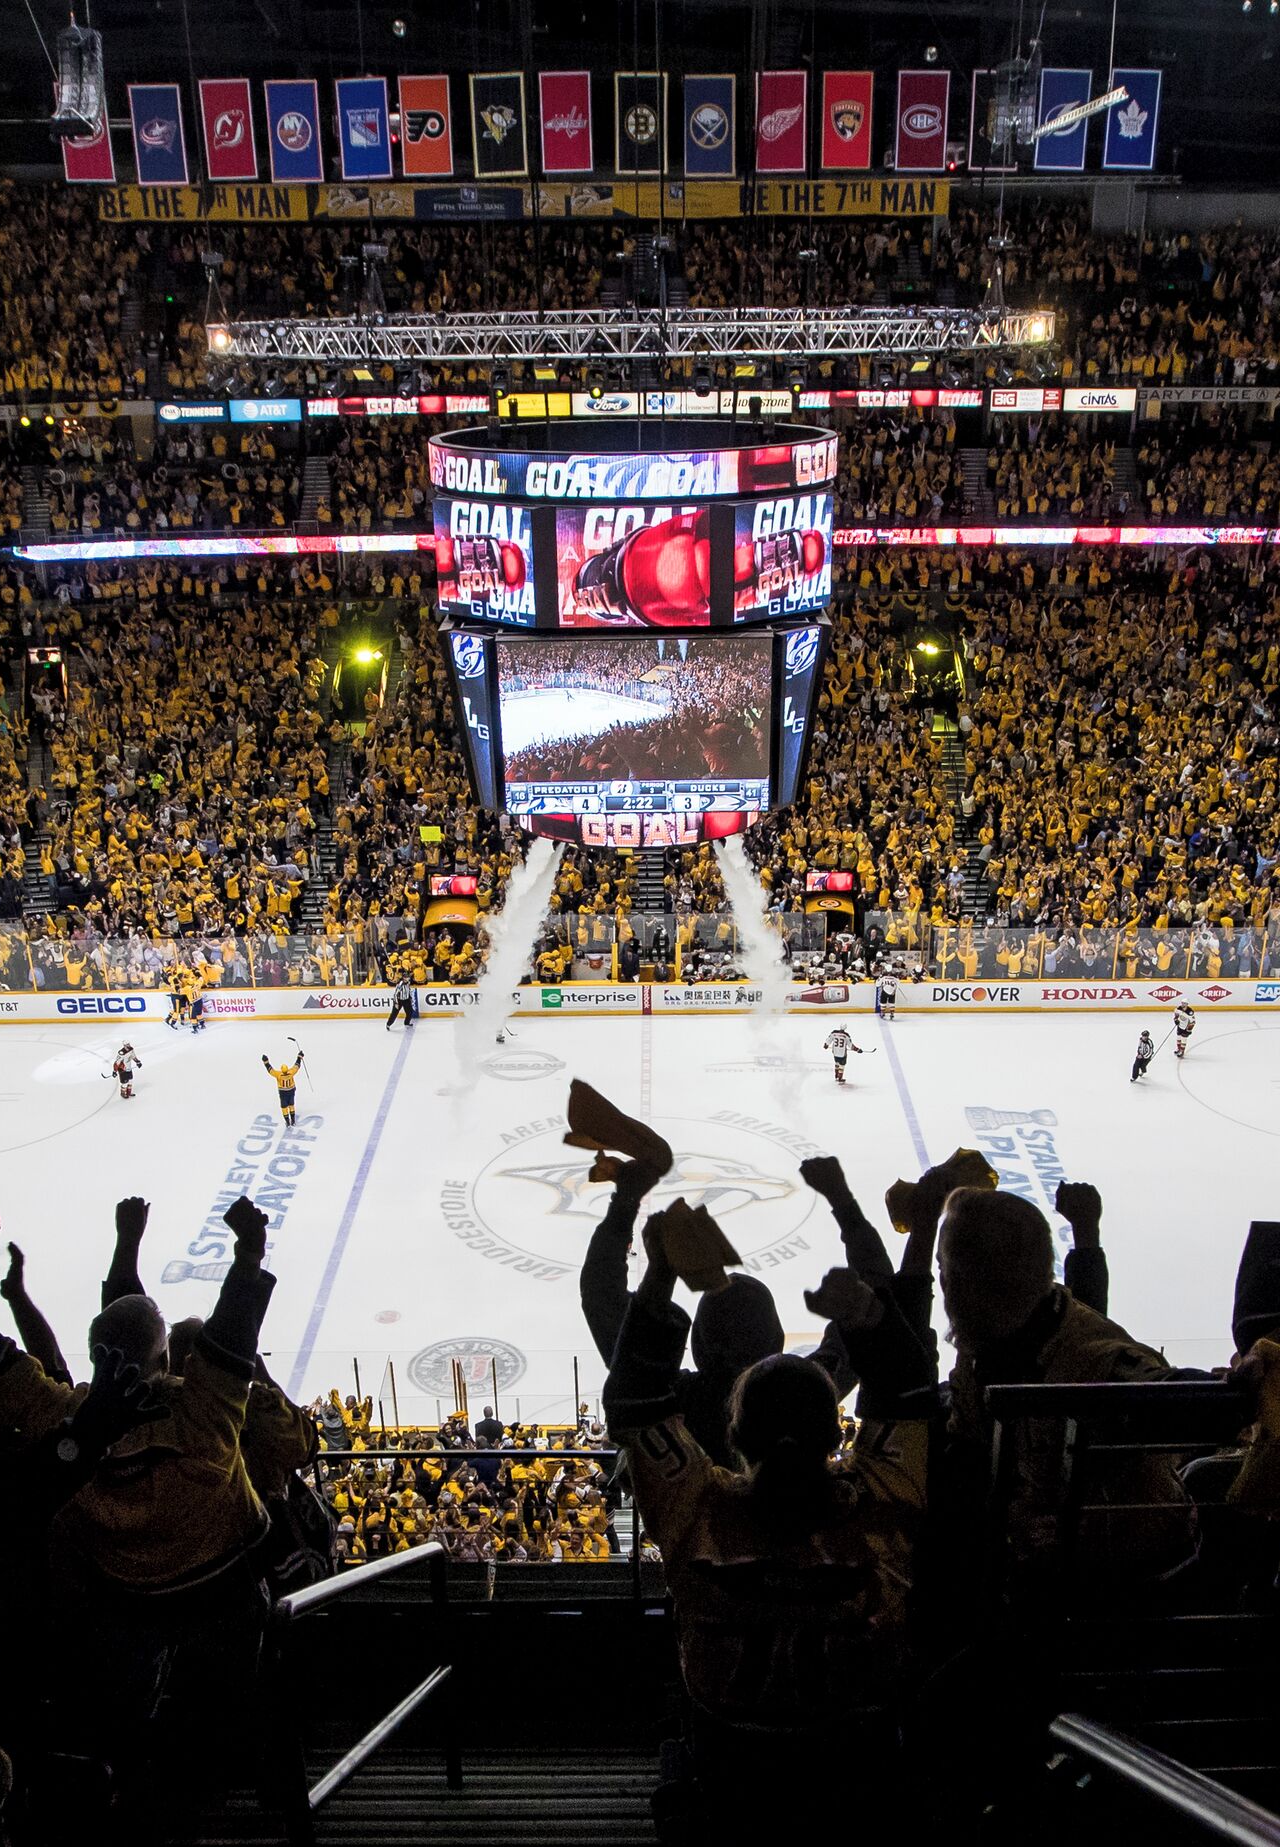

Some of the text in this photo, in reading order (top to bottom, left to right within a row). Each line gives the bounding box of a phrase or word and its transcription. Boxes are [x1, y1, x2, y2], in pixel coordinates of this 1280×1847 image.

[103, 187, 131, 218] BE
[139, 187, 185, 217] THE
[236, 186, 291, 217] MAN
[739, 183, 936, 213] BE THE 7TH MAN
[1138, 390, 1184, 400] GARY
[1192, 390, 1252, 400] FORCE
[260, 404, 287, 417] AT&T
[594, 397, 622, 412] Ford
[722, 398, 790, 409] BIDSTONE
[180, 406, 224, 418] TENNESSEE
[445, 456, 501, 495] GOAL
[451, 501, 530, 548] GOAL
[752, 494, 832, 543] GOAL
[534, 785, 596, 795] PREDATORS
[689, 784, 726, 792] DUCKS
[746, 789, 757, 797] 41
[515, 792, 526, 801] 16
[622, 796, 654, 810] 2:22
[684, 797, 693, 810] 3
[581, 798, 590, 811] 4
[581, 813, 698, 848] GOAL
[425, 992, 521, 1006] GATOE
[542, 989, 637, 1006] enterprise
[932, 986, 1021, 1002] DISCOVER
[1041, 988, 1137, 1001] HONDA
[1152, 989, 1178, 998] ORKIN
[1202, 989, 1228, 998] ORKIN
[57, 996, 146, 1015] GEICO
[216, 998, 256, 1006] DUNKIN'
[319, 993, 361, 1009] Coors
[216, 1005, 256, 1013] DONUTS
[833, 1038, 845, 1048] 33
[499, 1114, 566, 1145] AREN
[707, 1109, 829, 1159] BRIDGES
[188, 1113, 279, 1259] STANLEY CUP
[255, 1114, 325, 1249] LAYOFFS
[440, 1179, 574, 1281] BRIDGESTONE
[742, 1235, 812, 1275] AREN
